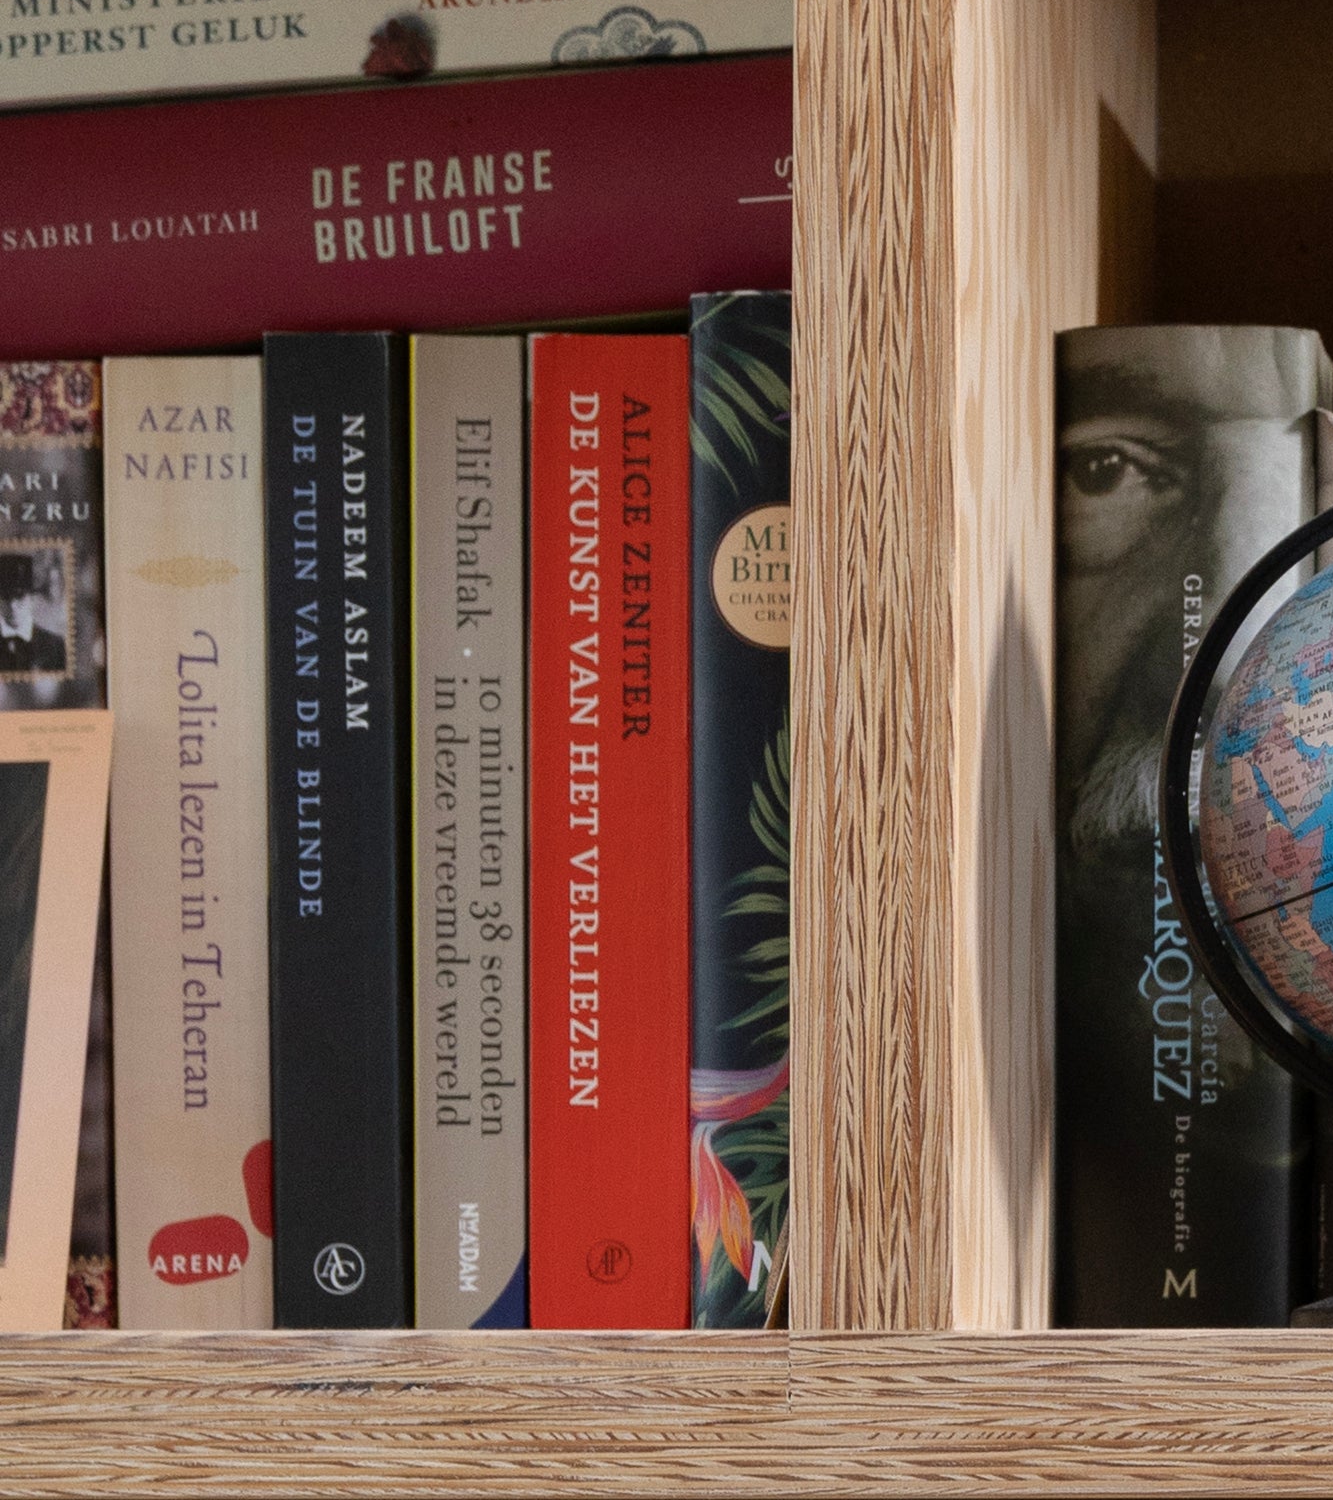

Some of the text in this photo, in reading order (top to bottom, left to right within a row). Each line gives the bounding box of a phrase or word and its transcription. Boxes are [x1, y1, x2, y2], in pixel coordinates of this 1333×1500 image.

[311, 150, 554, 210] DE FRANSE
[313, 205, 524, 263] BRUILOFT
[137, 407, 234, 433] AZAR
[125, 454, 249, 482] NAFISI
[342, 413, 370, 731] NADEEM ASLAM
[568, 391, 601, 1108] DE KUNST VAN HET VERLIEZEN
[150, 1253, 243, 1274] ARENA
